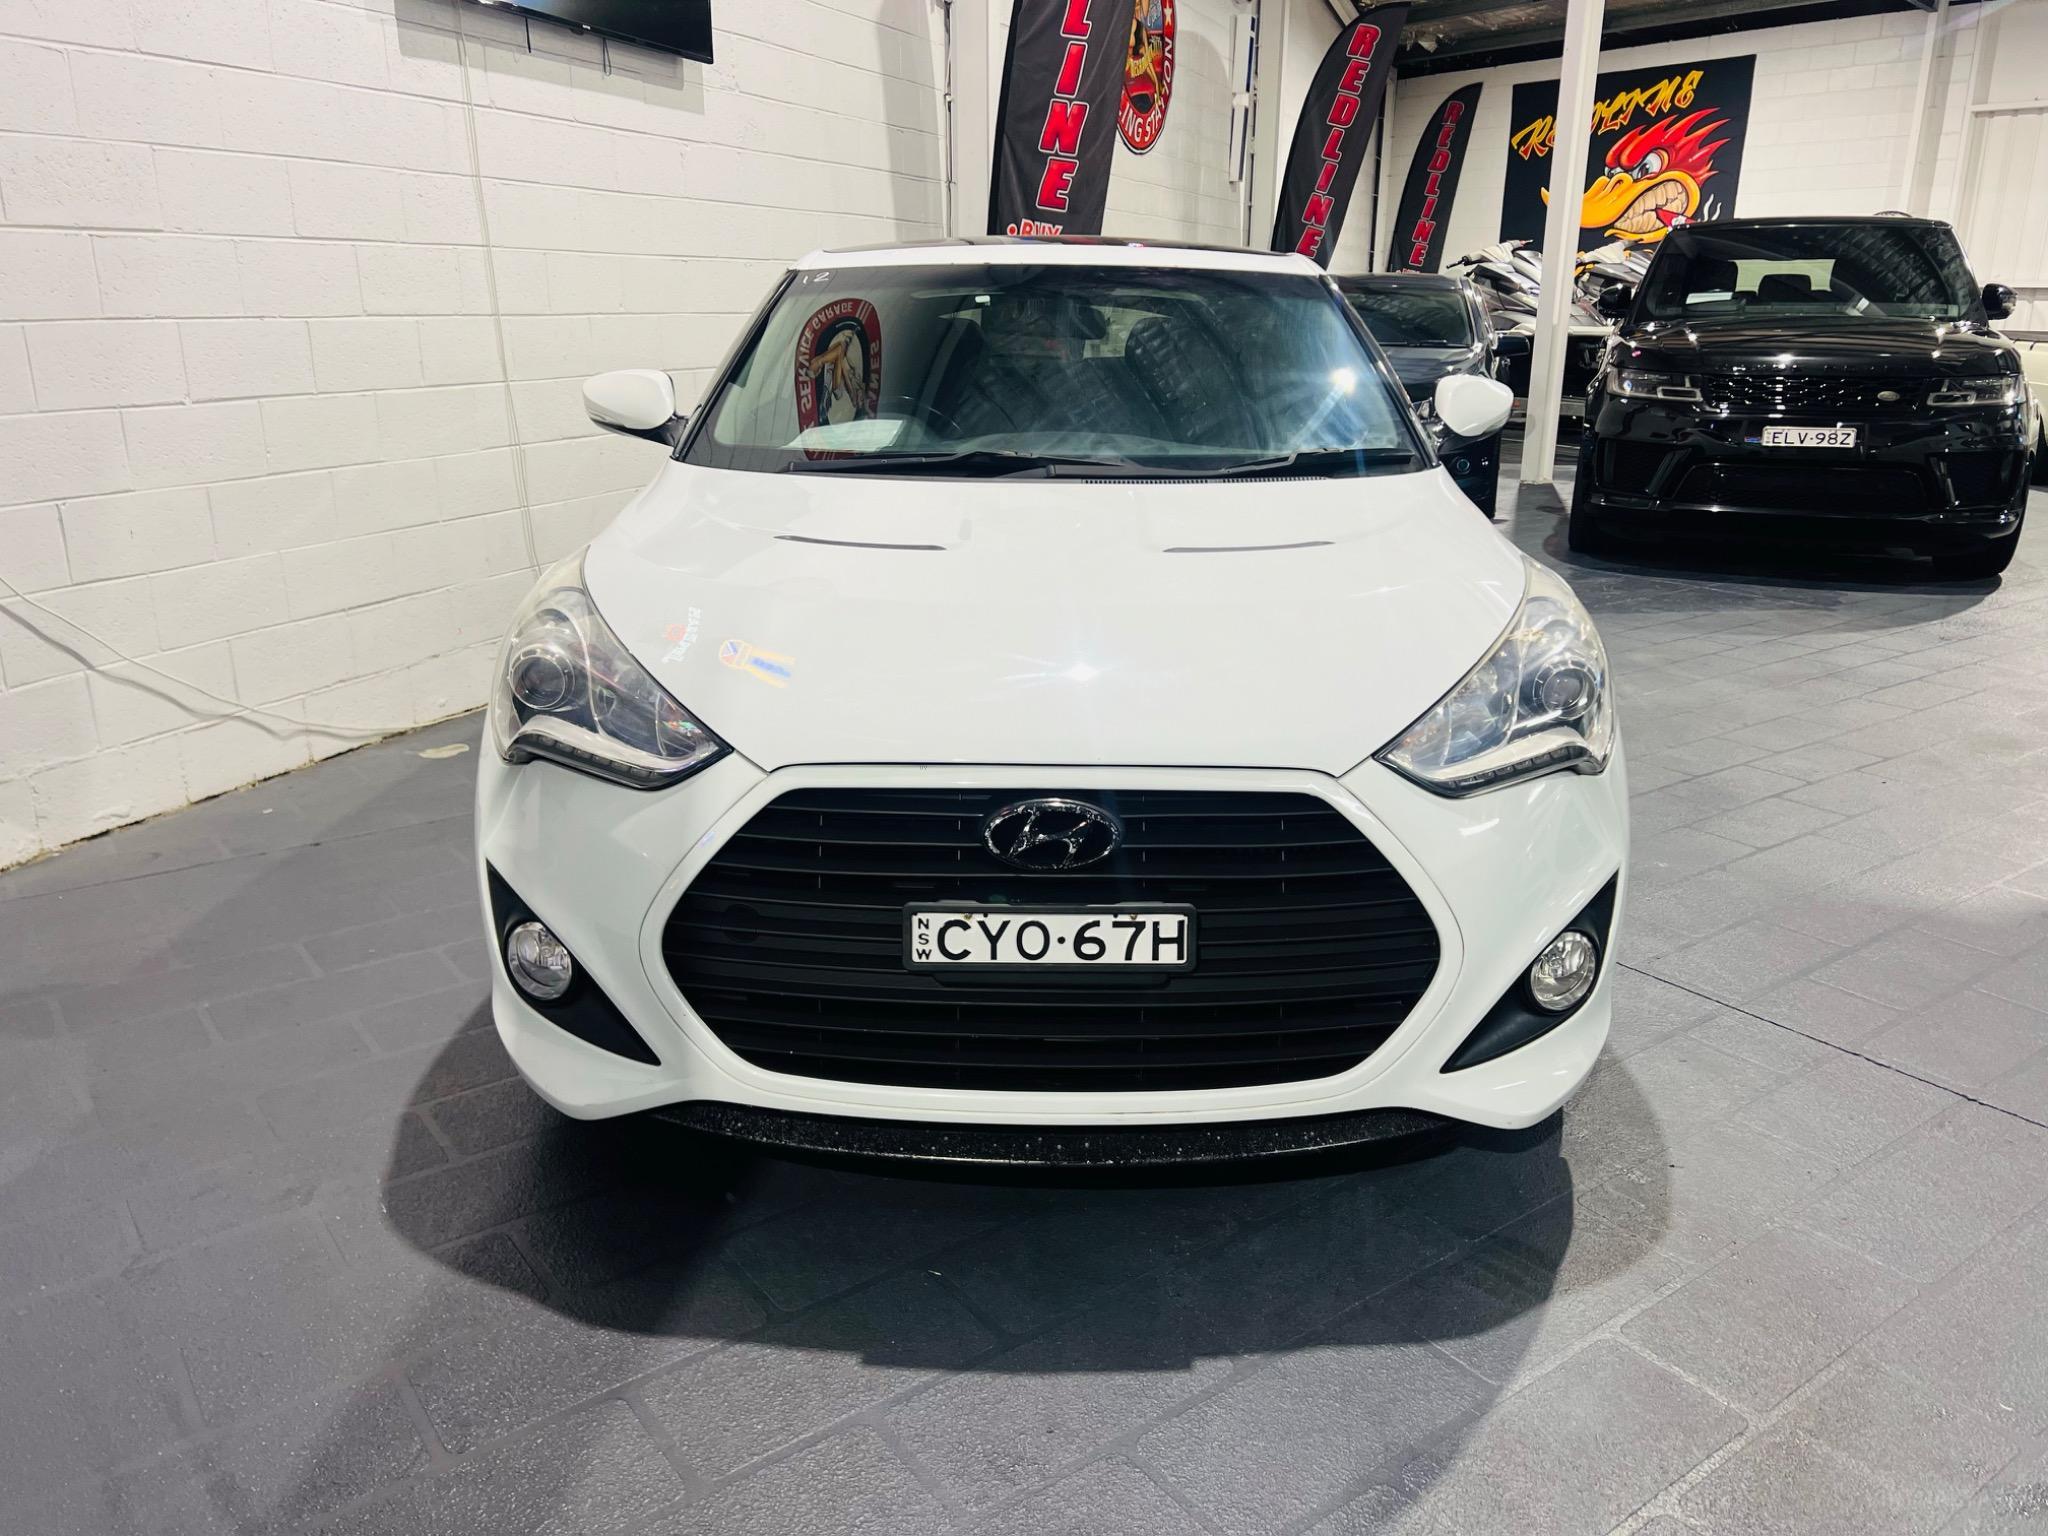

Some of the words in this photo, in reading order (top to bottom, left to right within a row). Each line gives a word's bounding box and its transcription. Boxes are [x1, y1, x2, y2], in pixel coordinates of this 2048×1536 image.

[1296, 23, 1382, 258] REDLINE
[1409, 100, 1465, 266] REDLINE
[915, 918, 932, 960] NSW
